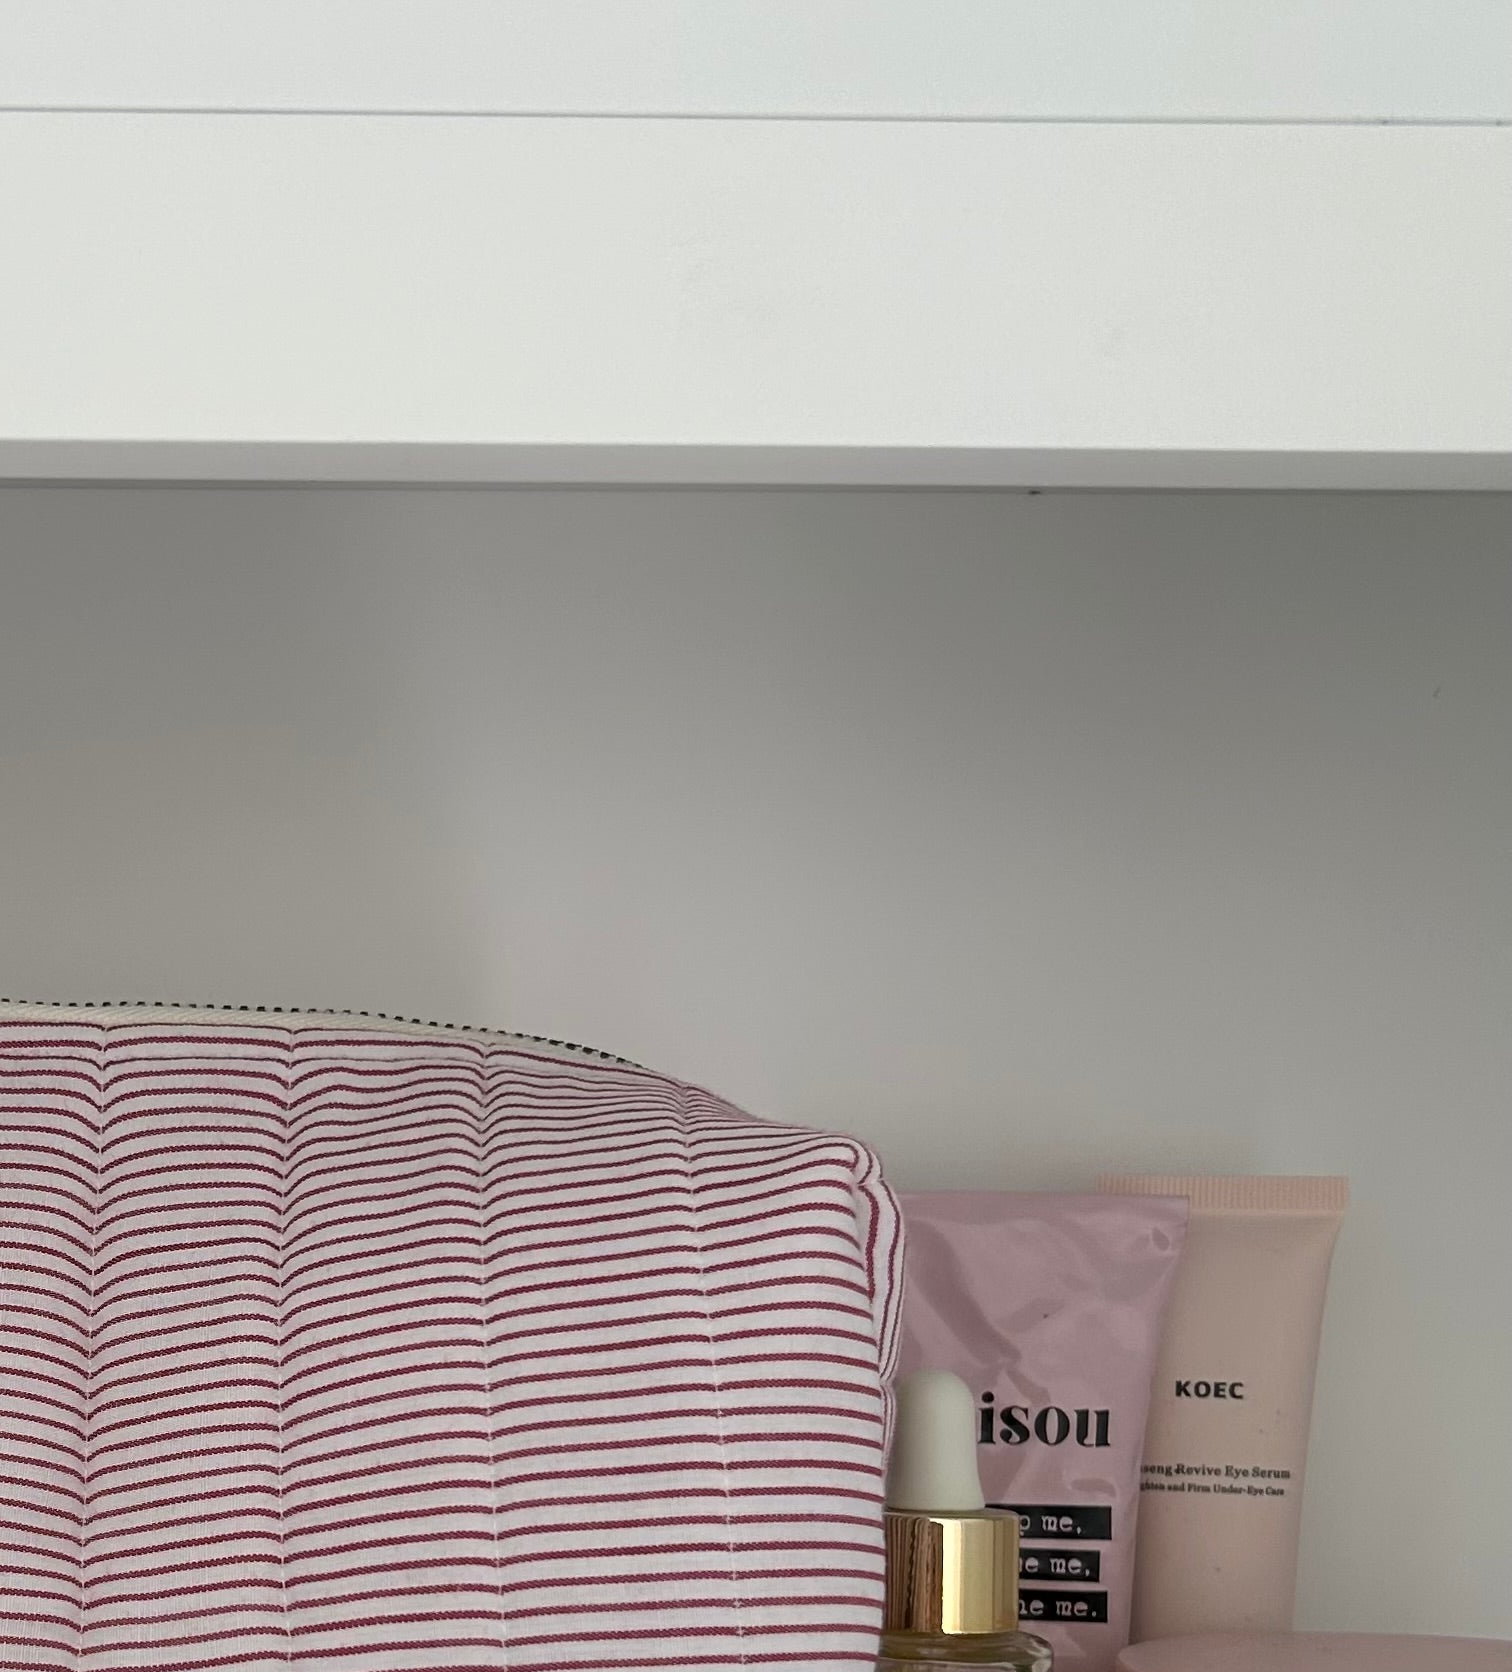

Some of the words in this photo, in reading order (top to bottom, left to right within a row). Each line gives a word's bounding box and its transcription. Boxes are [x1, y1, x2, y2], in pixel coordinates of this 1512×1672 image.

[1174, 1380, 1244, 1399] KOEC
[977, 1391, 1111, 1448] isou
[1140, 1465, 1173, 1477] seng
[1175, 1464, 1221, 1476] Revive
[1225, 1465, 1249, 1479] Eye
[1252, 1466, 1291, 1479] Serum
[1167, 1482, 1185, 1492] and
[1188, 1483, 1211, 1493] Firm
[1266, 1487, 1284, 1496] Care
[1041, 1515, 1081, 1535] me,
[1049, 1557, 1090, 1576] me,
[1056, 1600, 1097, 1617] me.
